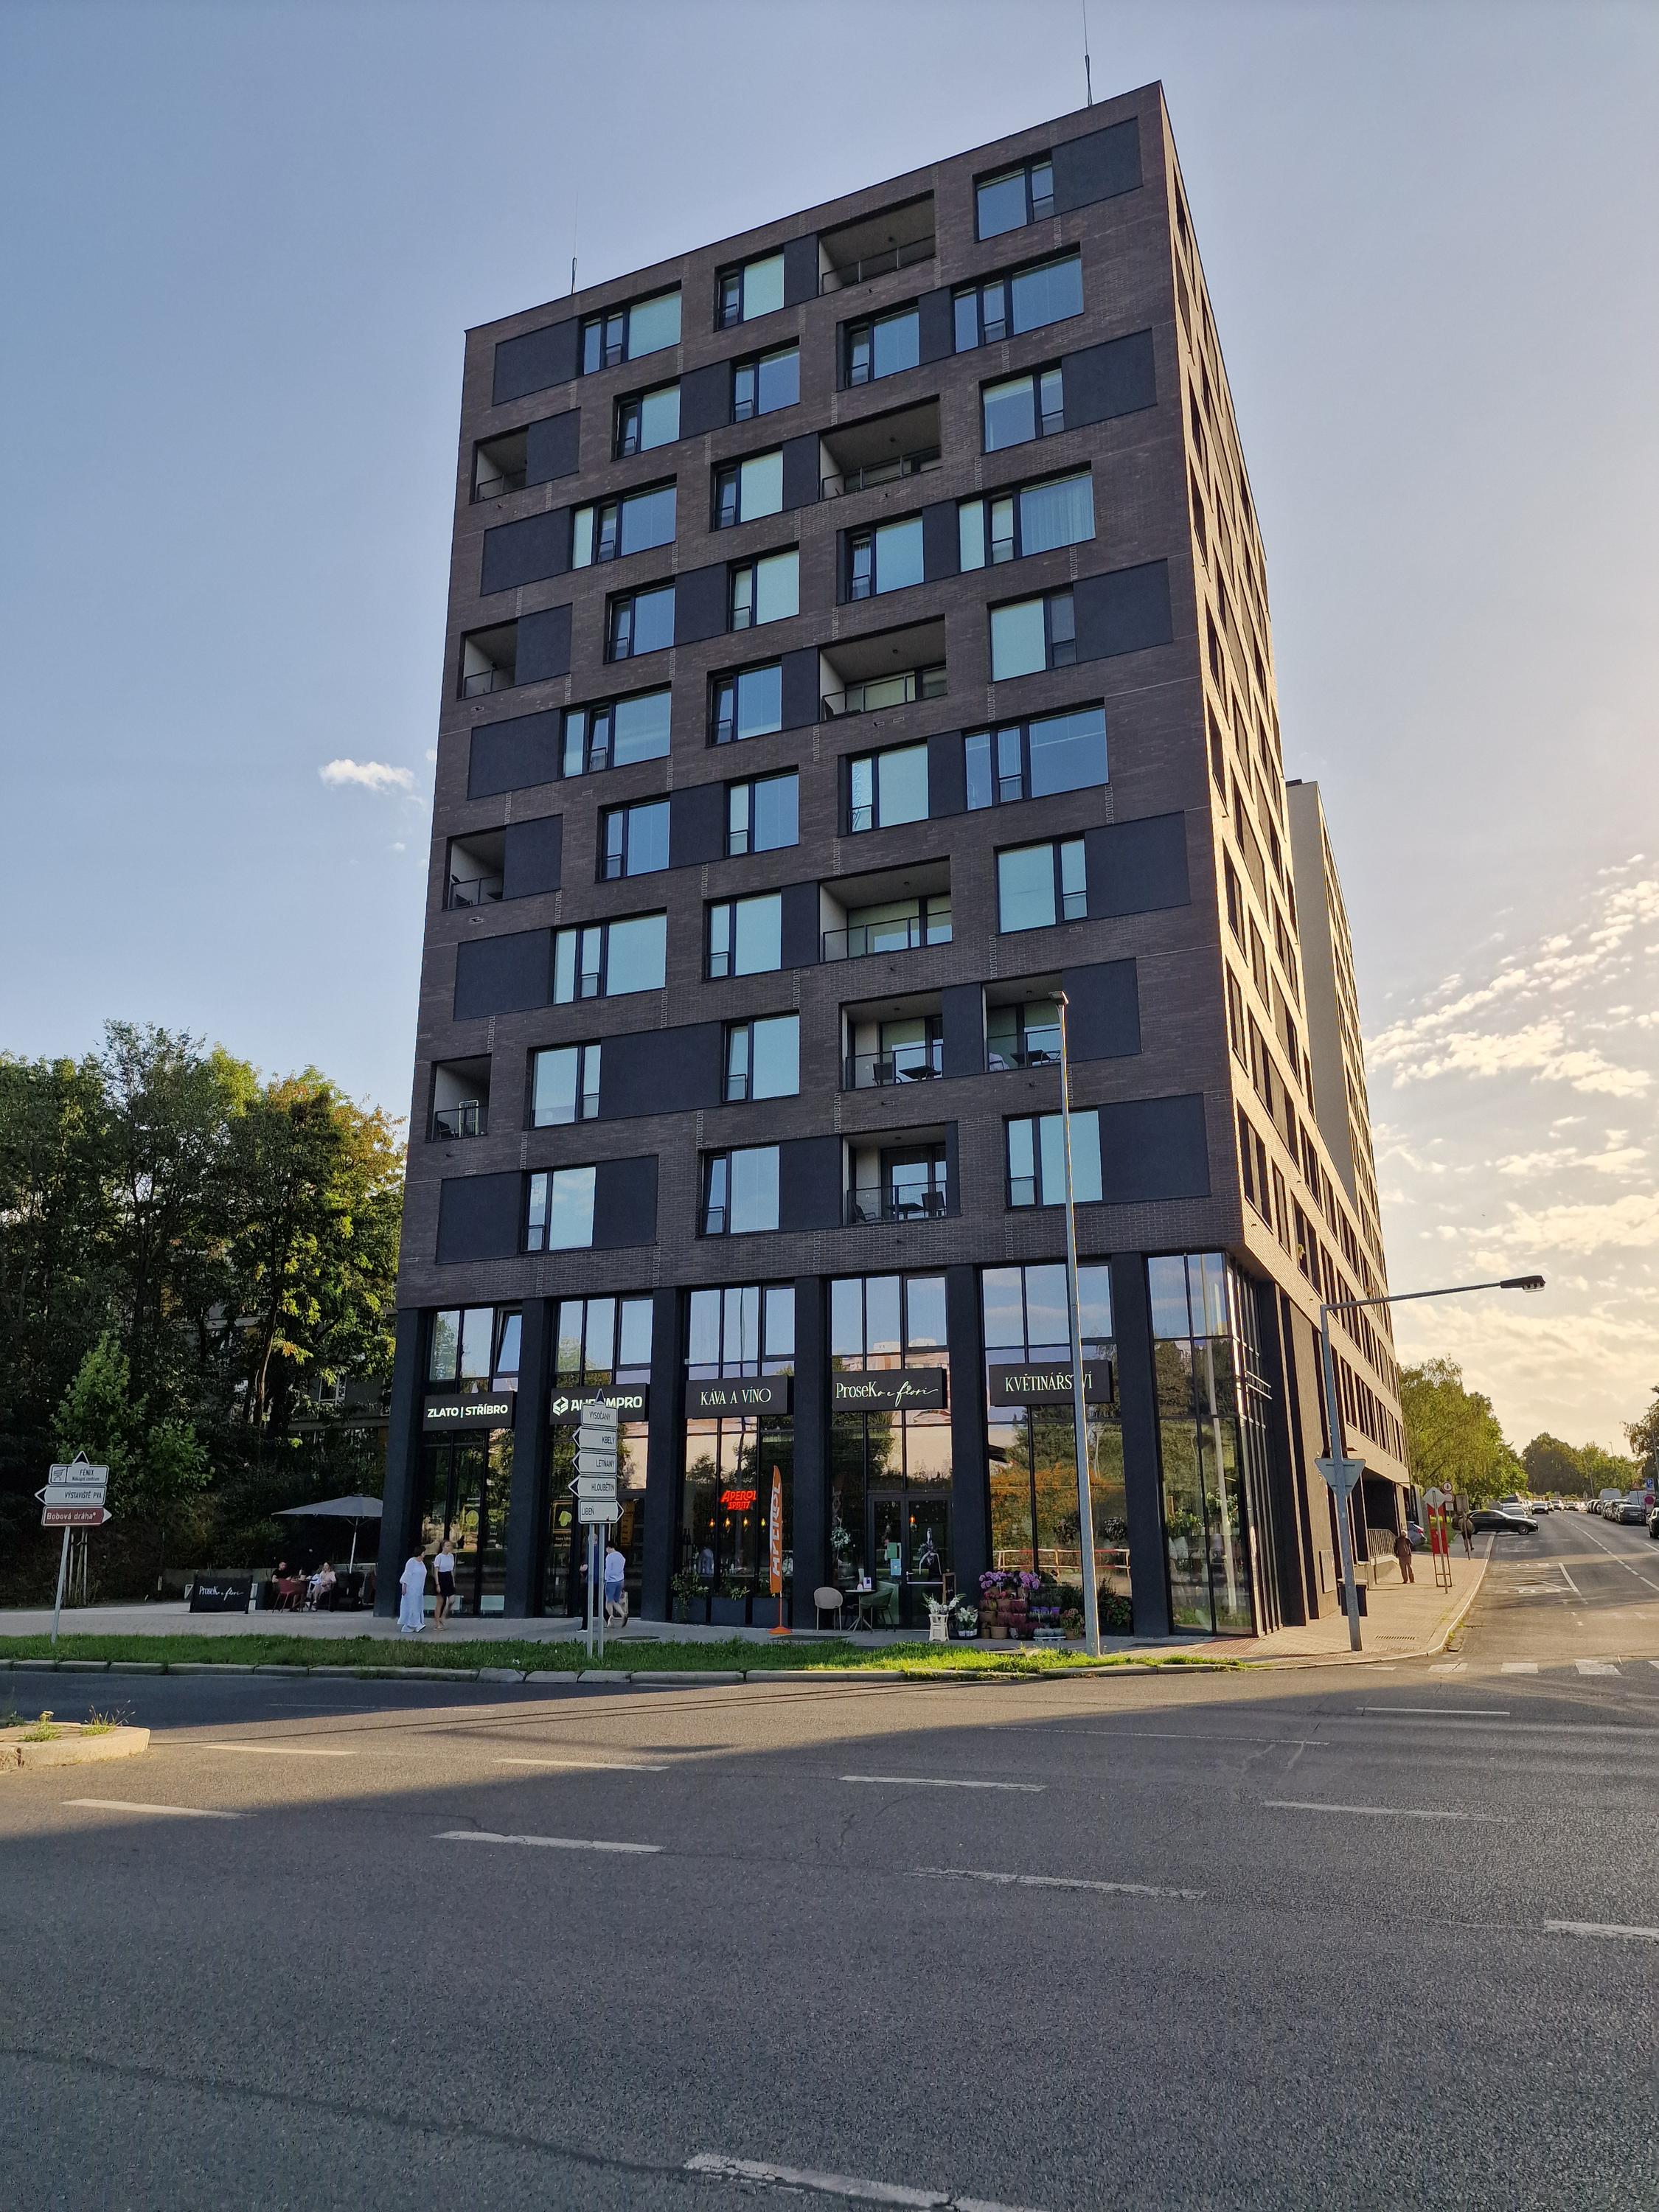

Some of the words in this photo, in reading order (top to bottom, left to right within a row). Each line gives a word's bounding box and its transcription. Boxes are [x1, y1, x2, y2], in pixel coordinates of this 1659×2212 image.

[1005, 1371, 1093, 1392] KVĚTINÁŘSVÍ
[700, 1388, 726, 1405] KÁVA
[730, 1390, 738, 1404] A
[742, 1386, 771, 1403] VÍNO
[427, 1407, 459, 1418] ZLATO
[465, 1403, 509, 1416] STŘÍBRO
[589, 1410, 611, 1421] VYSOČANY
[596, 1458, 615, 1468] LETŇANY
[46, 1512, 72, 1520] Bobová
